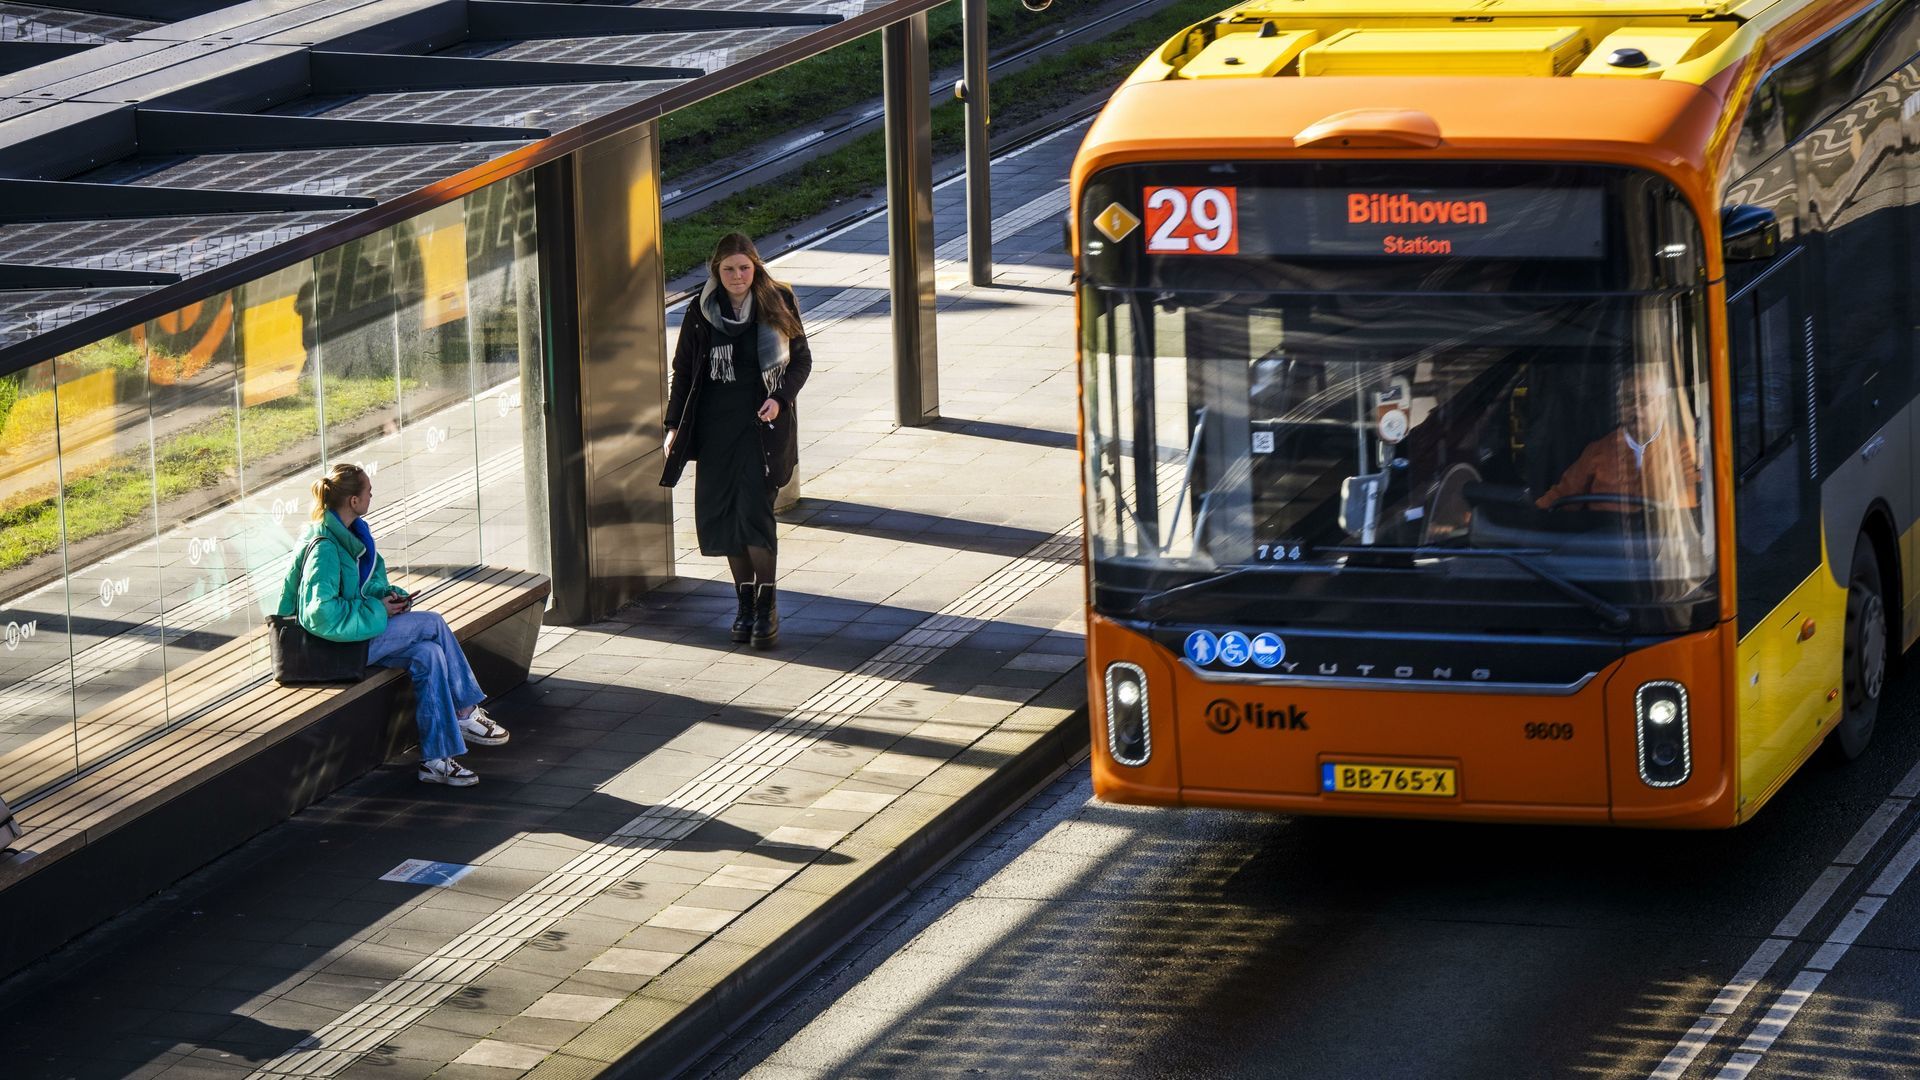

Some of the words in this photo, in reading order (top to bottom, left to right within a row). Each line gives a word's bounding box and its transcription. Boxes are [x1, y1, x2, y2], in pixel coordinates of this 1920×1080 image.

[1148, 188, 1232, 251] 29
[1348, 193, 1487, 224] Bilthoven
[1384, 235, 1451, 254] Station
[1258, 544, 1300, 560] 734
[1281, 661, 1491, 680] YUTONG
[1244, 702, 1310, 730] link
[1343, 767, 1447, 792] BB-765-X
